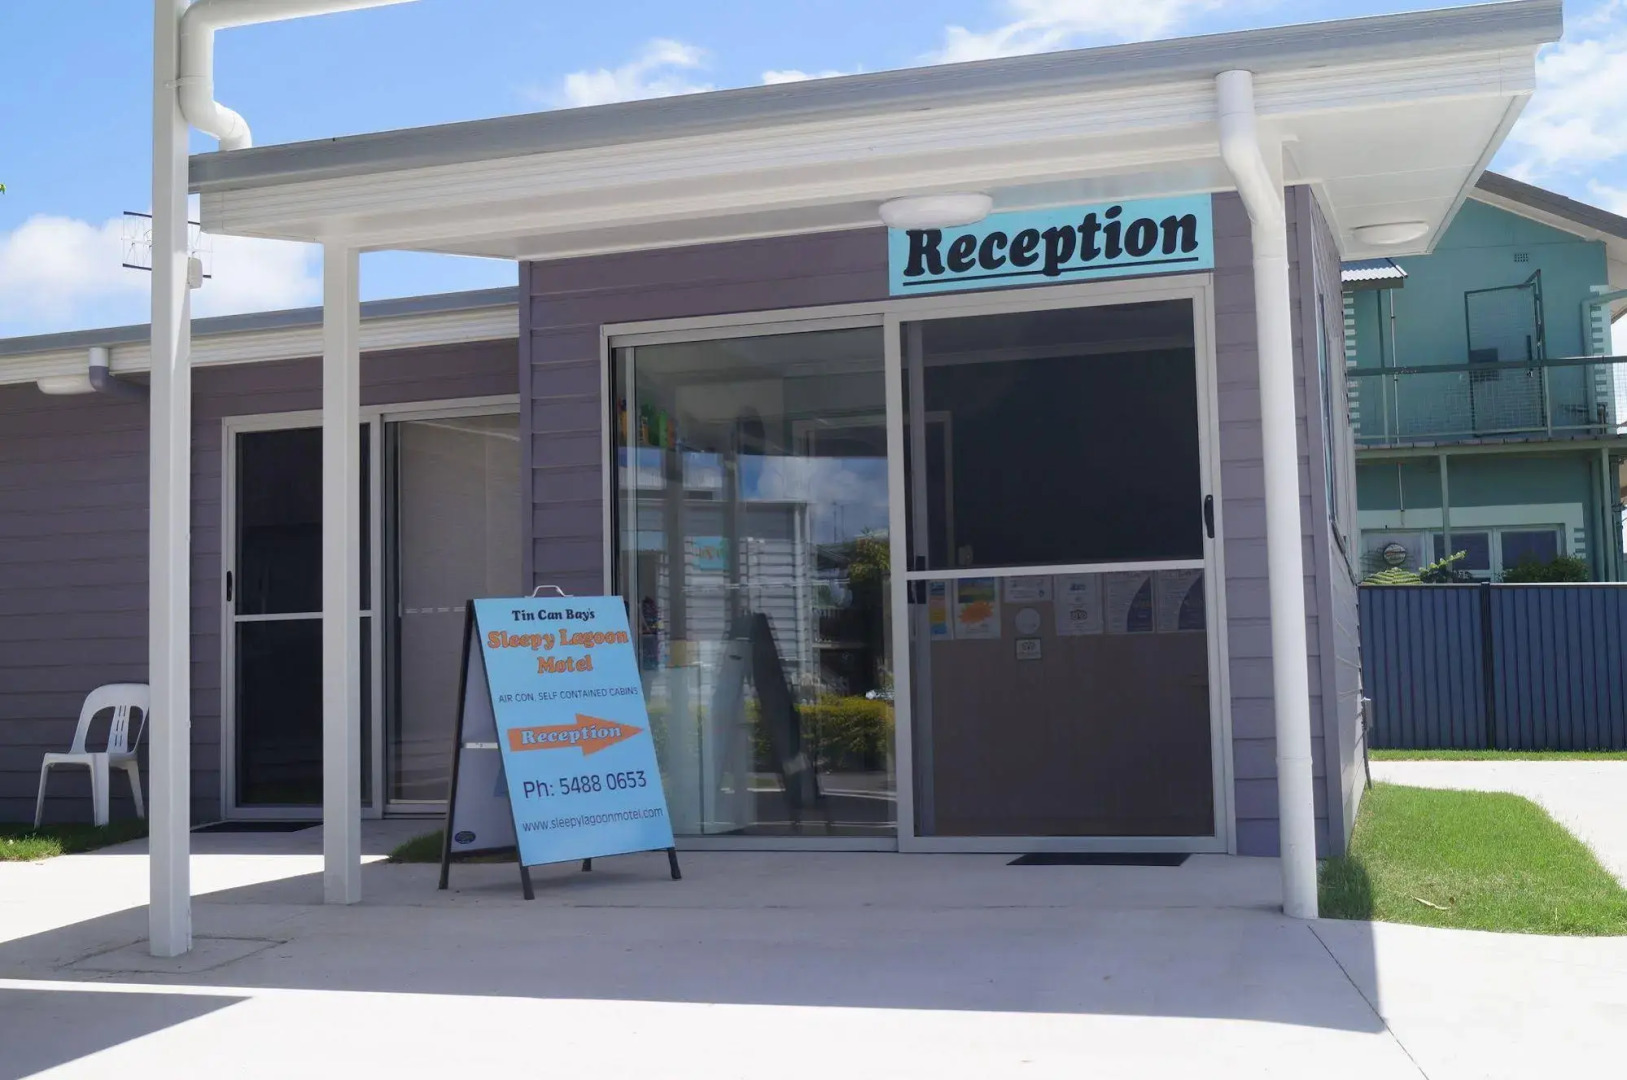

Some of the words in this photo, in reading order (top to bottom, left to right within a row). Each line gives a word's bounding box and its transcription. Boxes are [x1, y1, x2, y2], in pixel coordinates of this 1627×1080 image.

[903, 205, 1198, 276] Reception
[512, 609, 535, 621] Tin
[538, 609, 563, 620] Can
[565, 608, 596, 622] Bay's
[487, 630, 556, 651] Sleepy
[558, 628, 629, 648] Lagoon
[537, 654, 594, 674] Motel
[499, 694, 514, 703] AIR
[538, 691, 558, 701] SELF
[560, 687, 608, 699] CONTAINED
[609, 686, 639, 696] CABINS
[521, 725, 622, 745] Reception
[523, 779, 555, 799] Ph:
[559, 774, 602, 796] 5488
[606, 770, 647, 791] 0653
[522, 806, 664, 832] www.sleepylagoonmotel.com
